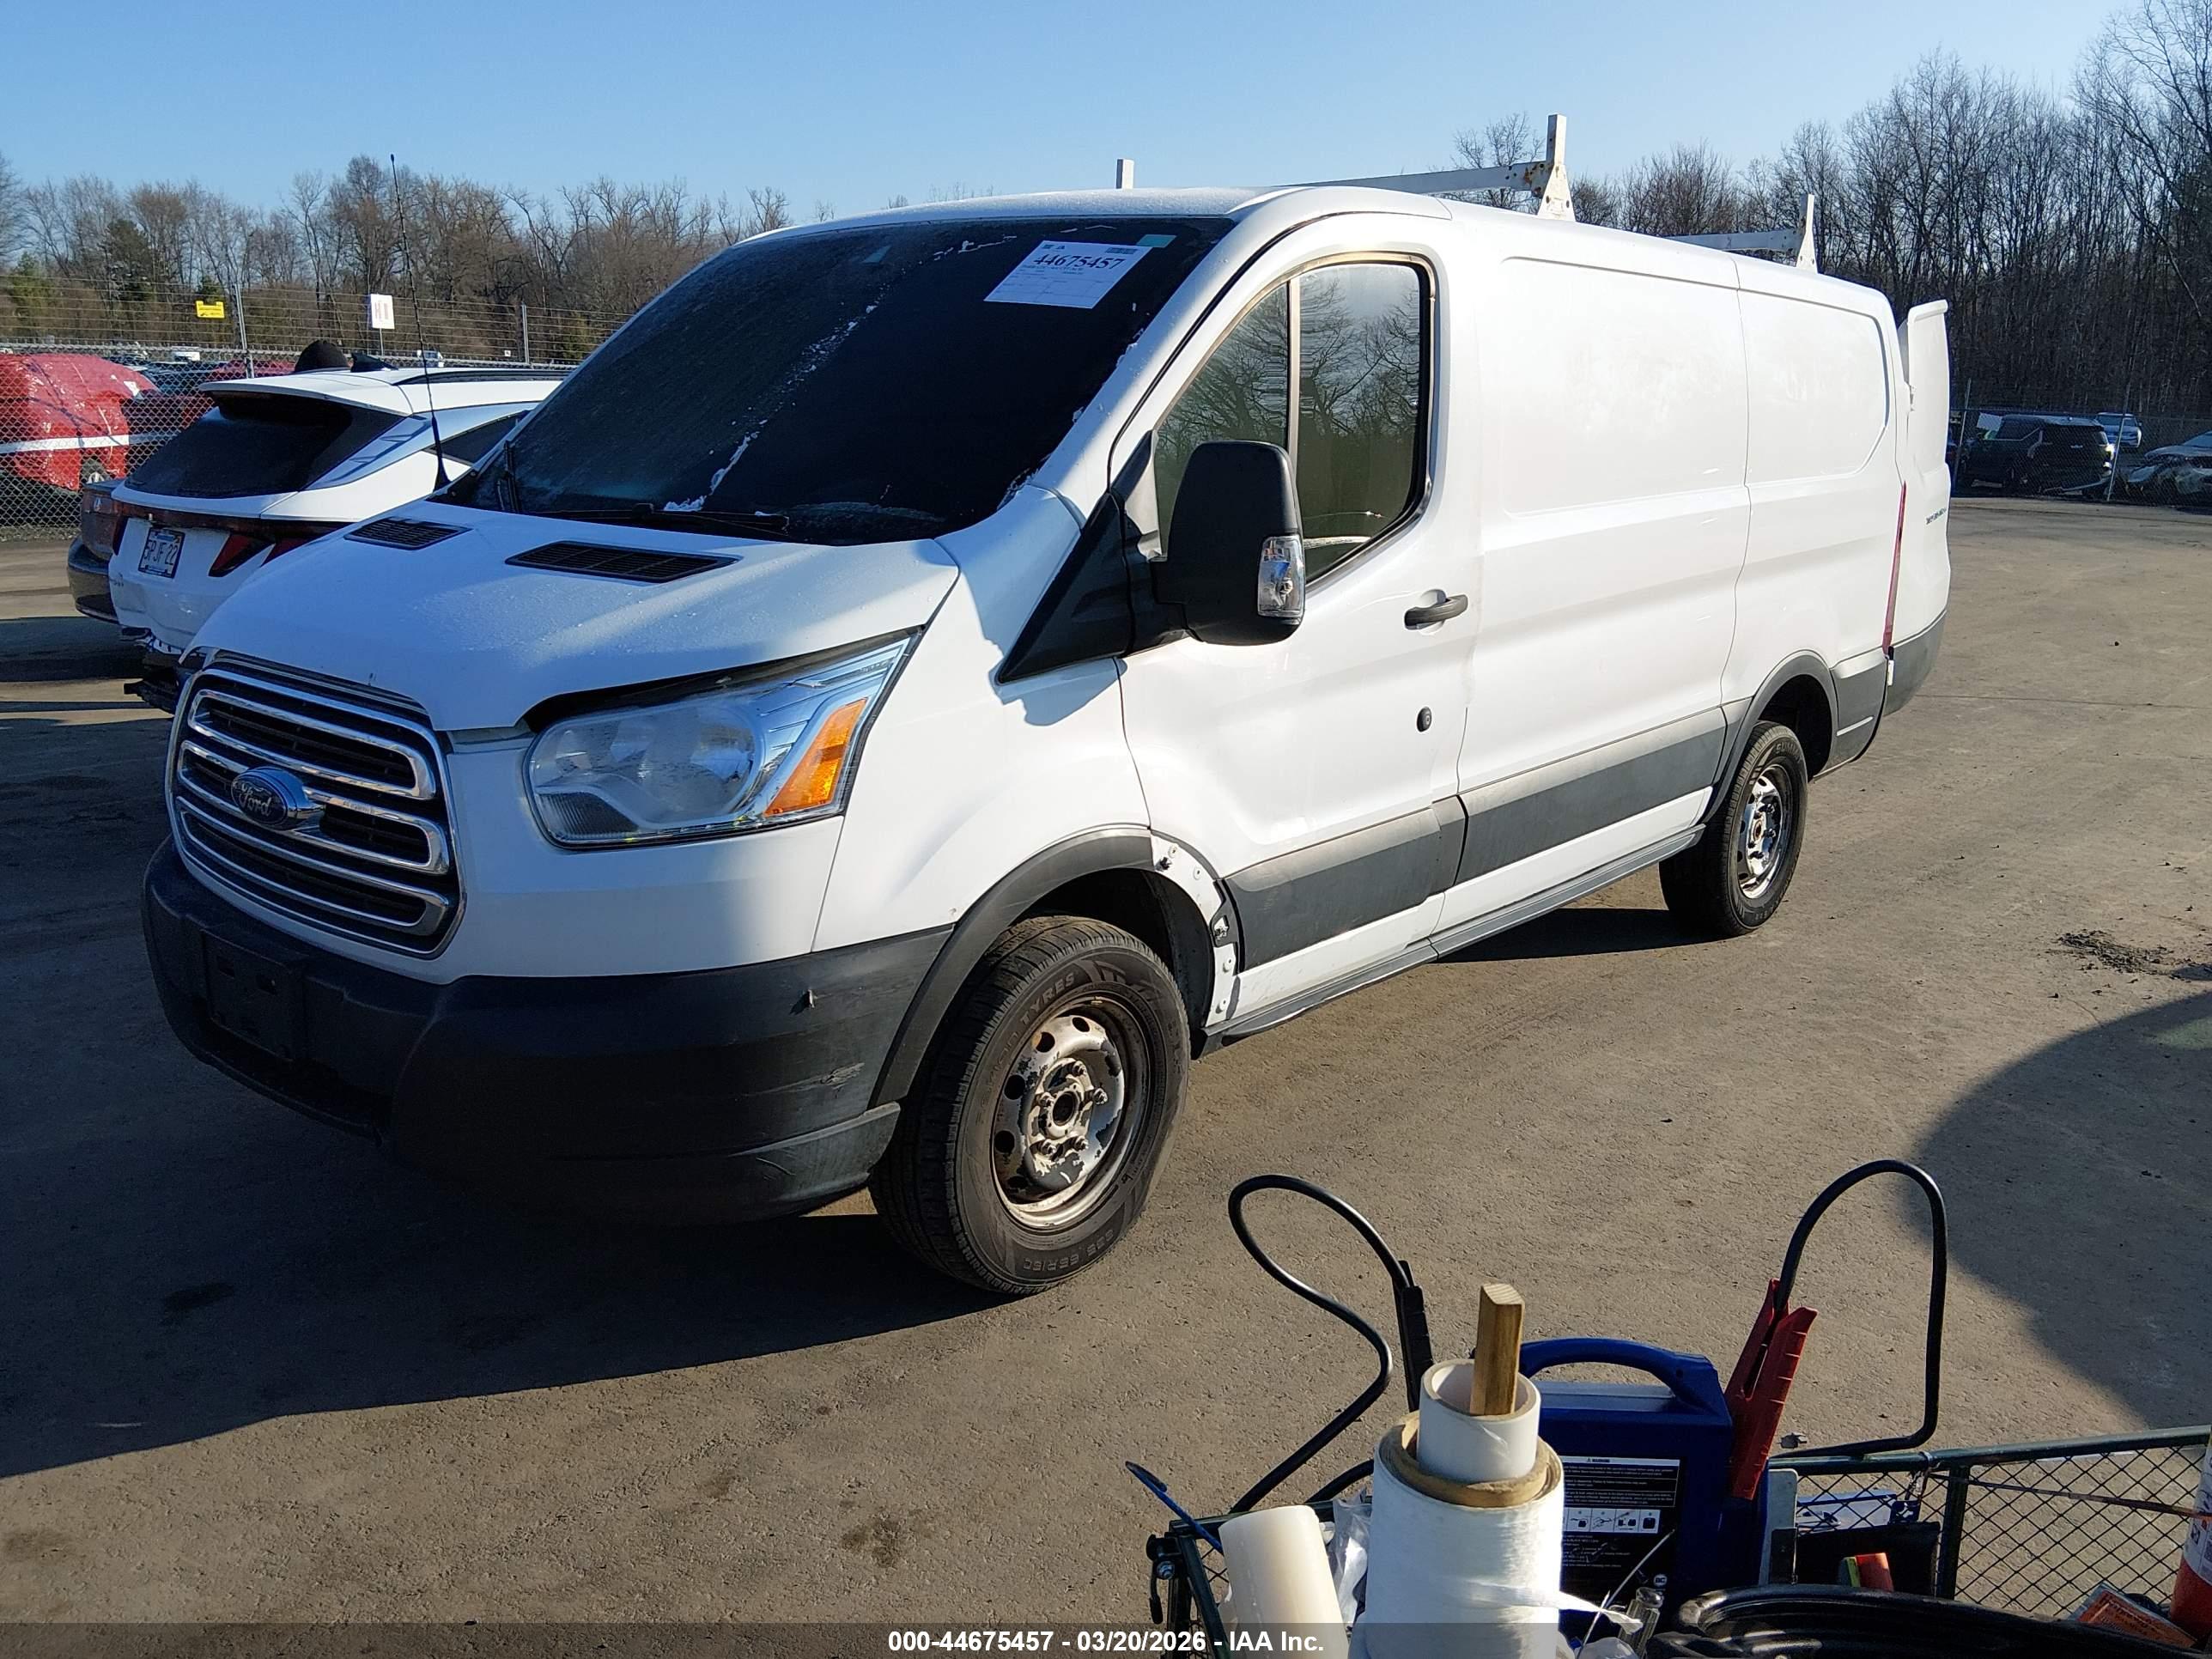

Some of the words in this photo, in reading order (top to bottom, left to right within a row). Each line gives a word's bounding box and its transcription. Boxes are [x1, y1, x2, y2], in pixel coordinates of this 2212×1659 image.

[1033, 253, 1127, 270] 44675457
[239, 787, 273, 817] Ford
[1019, 972, 1076, 1025] TYRES
